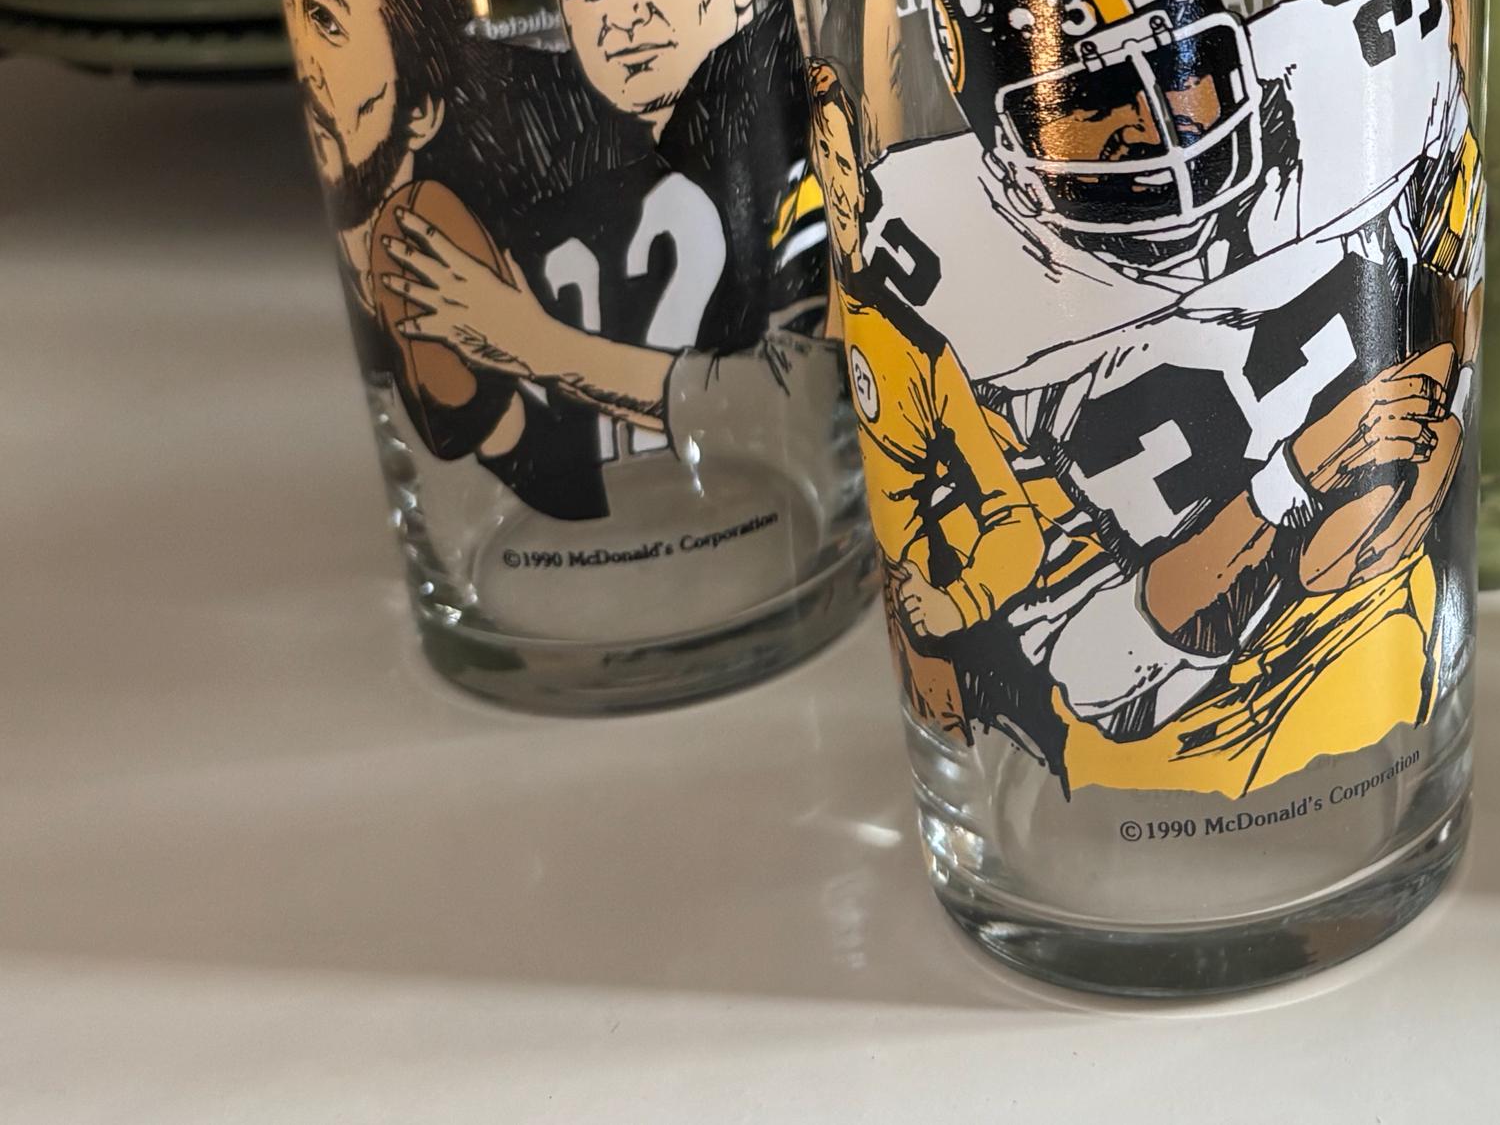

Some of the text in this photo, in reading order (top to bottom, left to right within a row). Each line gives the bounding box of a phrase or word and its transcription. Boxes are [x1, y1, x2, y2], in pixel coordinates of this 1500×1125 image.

[568, 540, 675, 568] McDonald's
[679, 510, 779, 552] Corporation
[1204, 794, 1324, 837] McDonald's
[1328, 748, 1421, 806] Corporation
